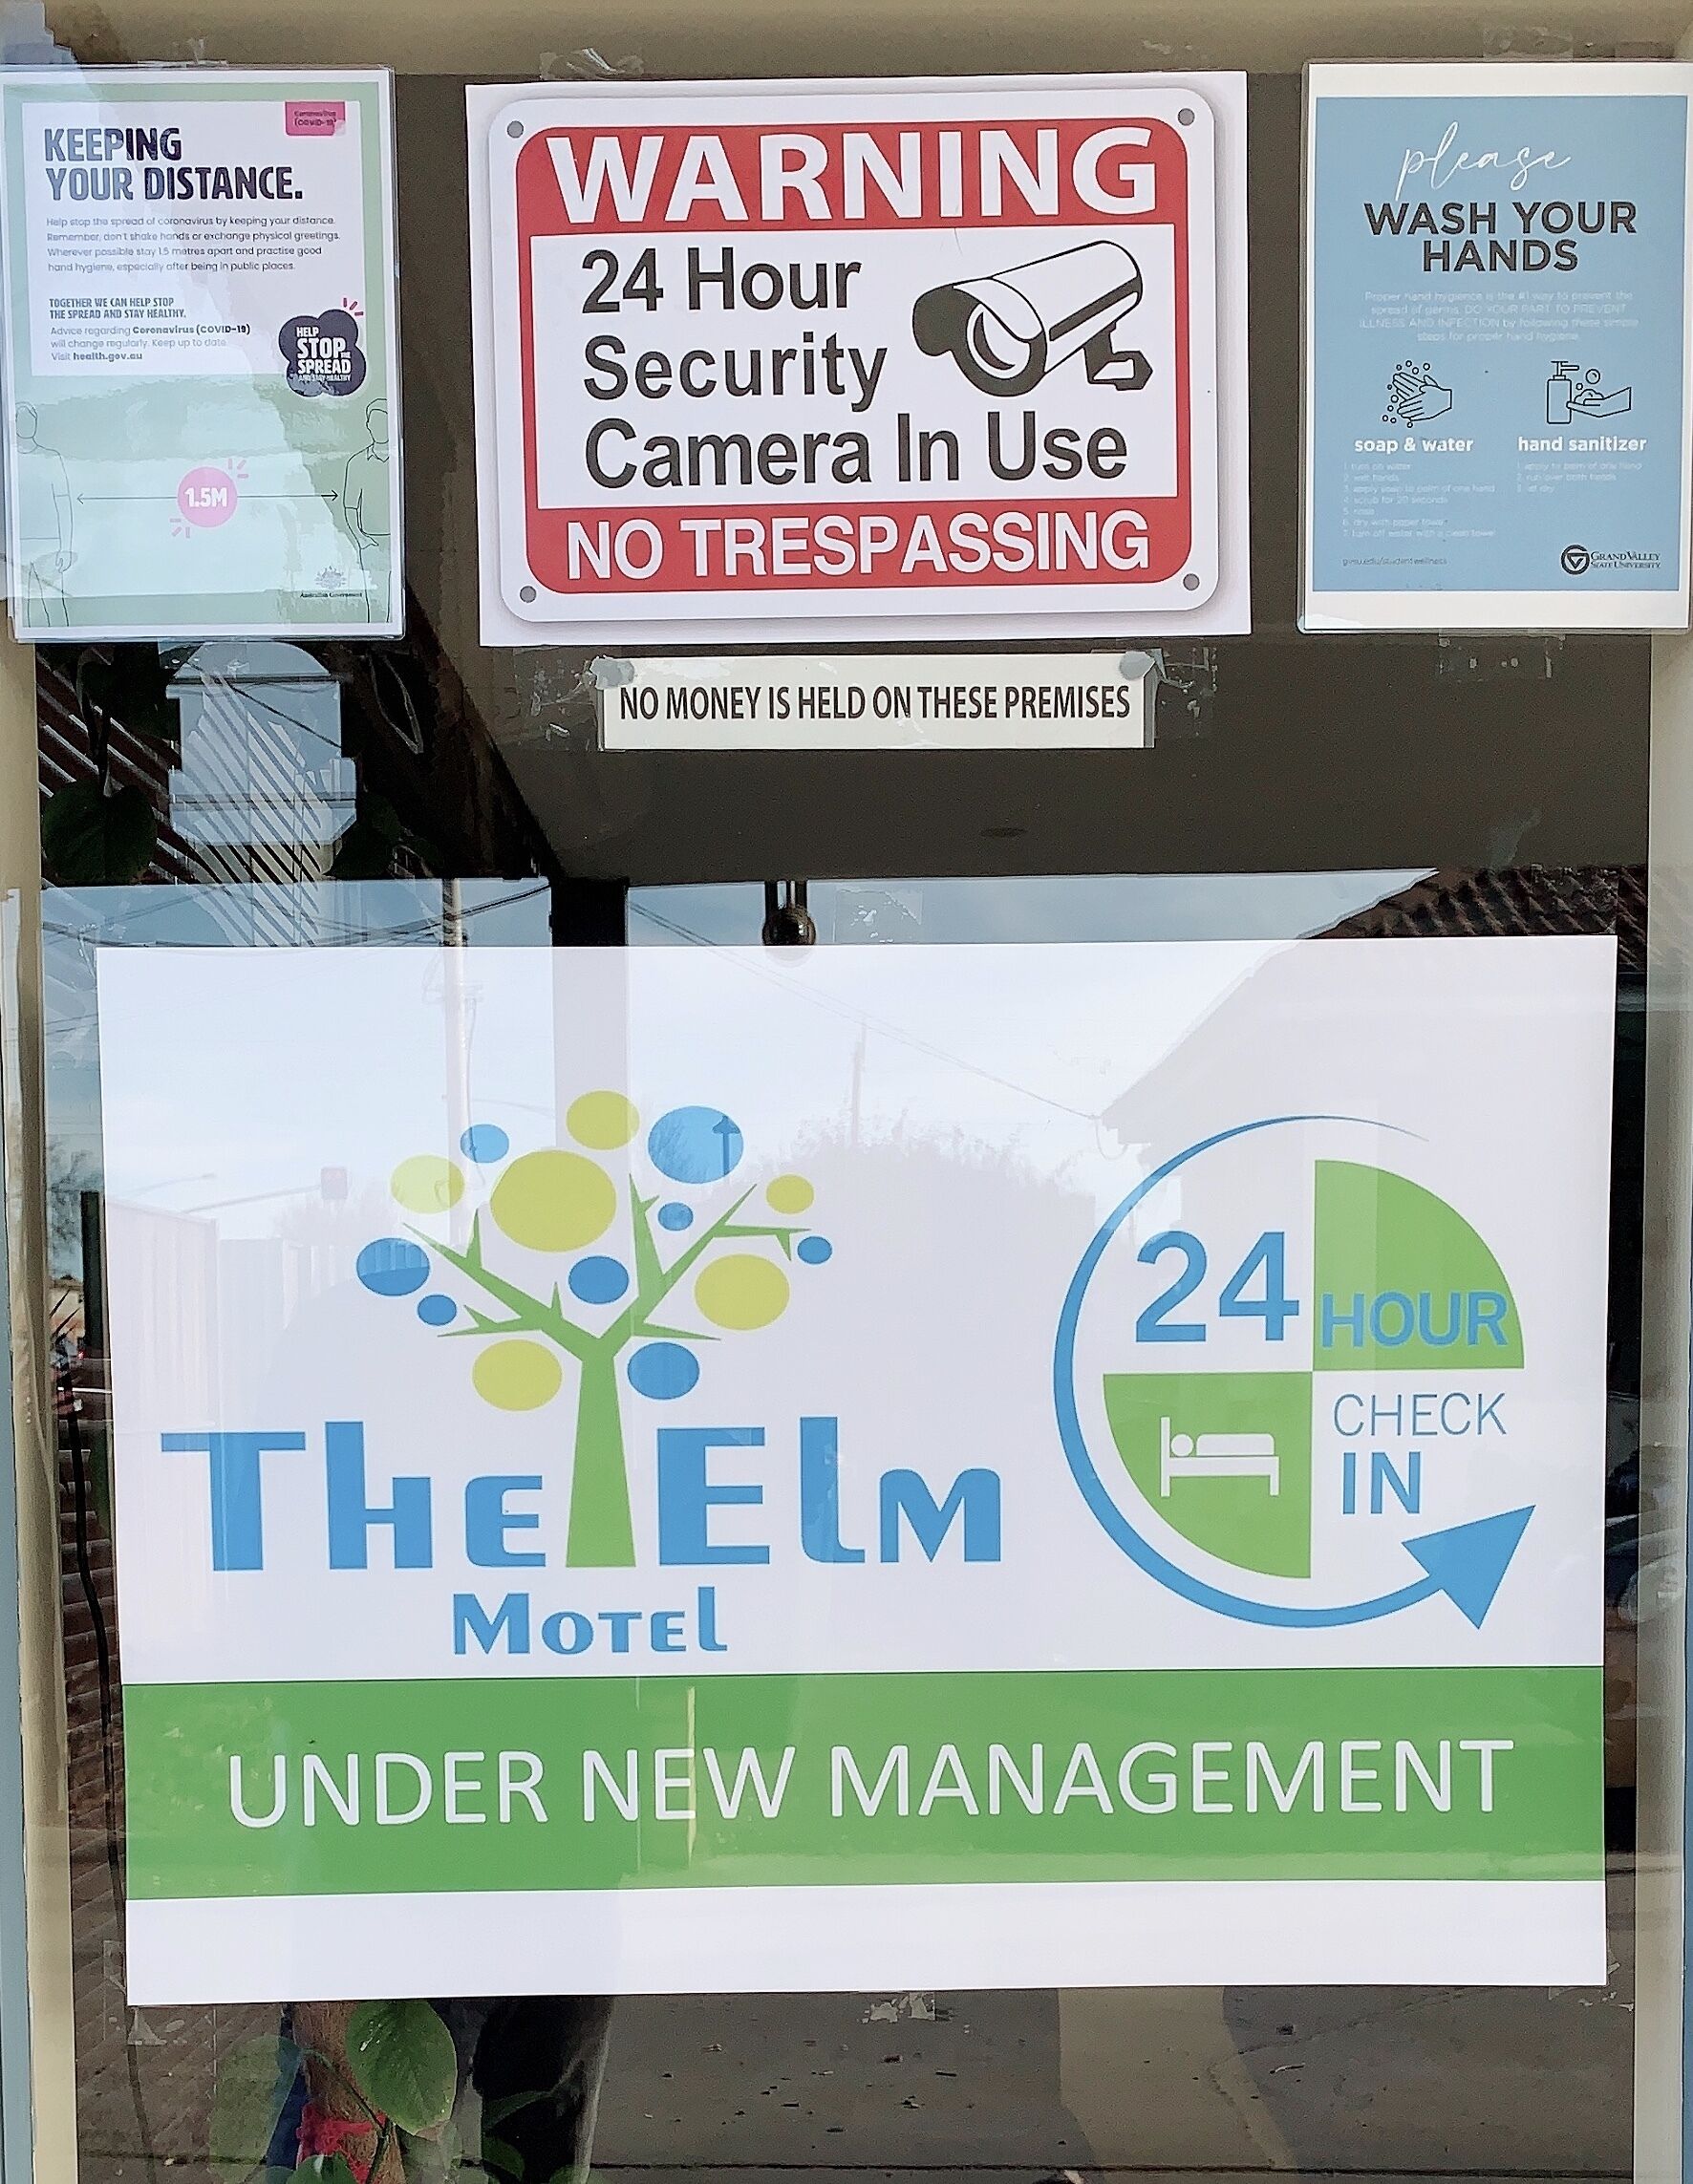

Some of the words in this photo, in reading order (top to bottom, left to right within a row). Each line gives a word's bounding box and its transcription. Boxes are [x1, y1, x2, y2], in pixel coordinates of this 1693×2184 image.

[44, 127, 182, 161] KEEPING
[1394, 121, 1572, 202] please
[46, 167, 134, 201] YOUR
[144, 166, 303, 200] DISTANCE.
[545, 127, 1157, 225] WARNING
[46, 218, 68, 227] Help
[70, 218, 91, 227] stop
[111, 218, 143, 227] spread
[146, 217, 155, 225] of
[158, 217, 213, 225] coronavirus
[216, 216, 227, 227] by
[229, 216, 268, 227] keeping
[269, 217, 290, 226] your
[292, 216, 335, 225] distance.
[1362, 202, 1497, 236] WASH
[1511, 201, 1638, 234] YOUR
[47, 233, 101, 243] Remember,
[103, 232, 126, 241] don't
[130, 232, 158, 241] shake
[161, 231, 189, 241] hands
[204, 231, 250, 243] exchange
[252, 231, 292, 243] physical
[294, 231, 340, 243] greetings.
[96, 246, 134, 258] possible
[136, 247, 155, 258] stay
[172, 247, 204, 256] metres
[207, 246, 233, 257] apart
[235, 246, 254, 255] and
[256, 246, 294, 257] practise
[297, 246, 322, 257] good
[1423, 239, 1578, 272] HANDS
[48, 263, 73, 271] hand
[75, 263, 115, 273] hygiene,
[117, 262, 164, 273] especially
[166, 262, 187, 270] after
[191, 262, 218, 271] being
[231, 262, 260, 271] public
[262, 262, 295, 271] places.
[581, 248, 664, 313] 24
[687, 246, 861, 311] Hour
[50, 298, 92, 308] TOGETHER
[95, 298, 107, 308] WE
[110, 298, 128, 308] CAN
[130, 298, 151, 307] HELP
[153, 298, 174, 307] STOP
[50, 310, 65, 319] THE
[68, 310, 101, 319] SPREAD
[103, 310, 122, 319] AND
[124, 310, 145, 318] STAY
[147, 309, 187, 318] HEALTHY.
[50, 327, 82, 335] Advice
[84, 326, 131, 337] regarding
[133, 325, 194, 334] Coronavirus
[196, 323, 251, 336] (COVID-19)
[296, 327, 319, 337] HELP
[68, 339, 104, 350] change
[106, 338, 150, 350] regularly.
[152, 338, 176, 349] Keep
[178, 340, 191, 349] up
[192, 338, 203, 347] to
[297, 338, 346, 359] STOP
[52, 352, 72, 361] Visit
[73, 352, 142, 363] health.gov.au
[298, 359, 352, 375] SPREAD
[584, 332, 888, 412] Security
[585, 418, 871, 488] Camera
[897, 413, 959, 482] In
[987, 410, 1126, 480] Use
[1354, 438, 1398, 455] soap
[1404, 438, 1416, 453] &
[1422, 438, 1474, 453] water
[1517, 437, 1563, 452] hand
[1568, 436, 1647, 452] sanitizer
[184, 487, 227, 508] 1.5M
[566, 519, 665, 580] NO
[679, 509, 1150, 577] TRESPASSING
[1591, 550, 1626, 560] GRAND
[620, 686, 659, 720] NO
[666, 686, 761, 720] MONEY
[768, 686, 791, 720] IS
[798, 686, 866, 719] HELD
[872, 685, 911, 718] ON
[917, 686, 998, 718] THESE
[1004, 685, 1131, 718] PREMISES
[1135, 1231, 1299, 1342] 24
[1320, 1291, 1509, 1348] HOUR
[1334, 1392, 1508, 1437] CHECK
[1342, 1451, 1422, 1515] IN
[229, 1749, 549, 1829] UNDER
[582, 1745, 796, 1823] NEW
[830, 1739, 1515, 1818] MANAGEMENT
